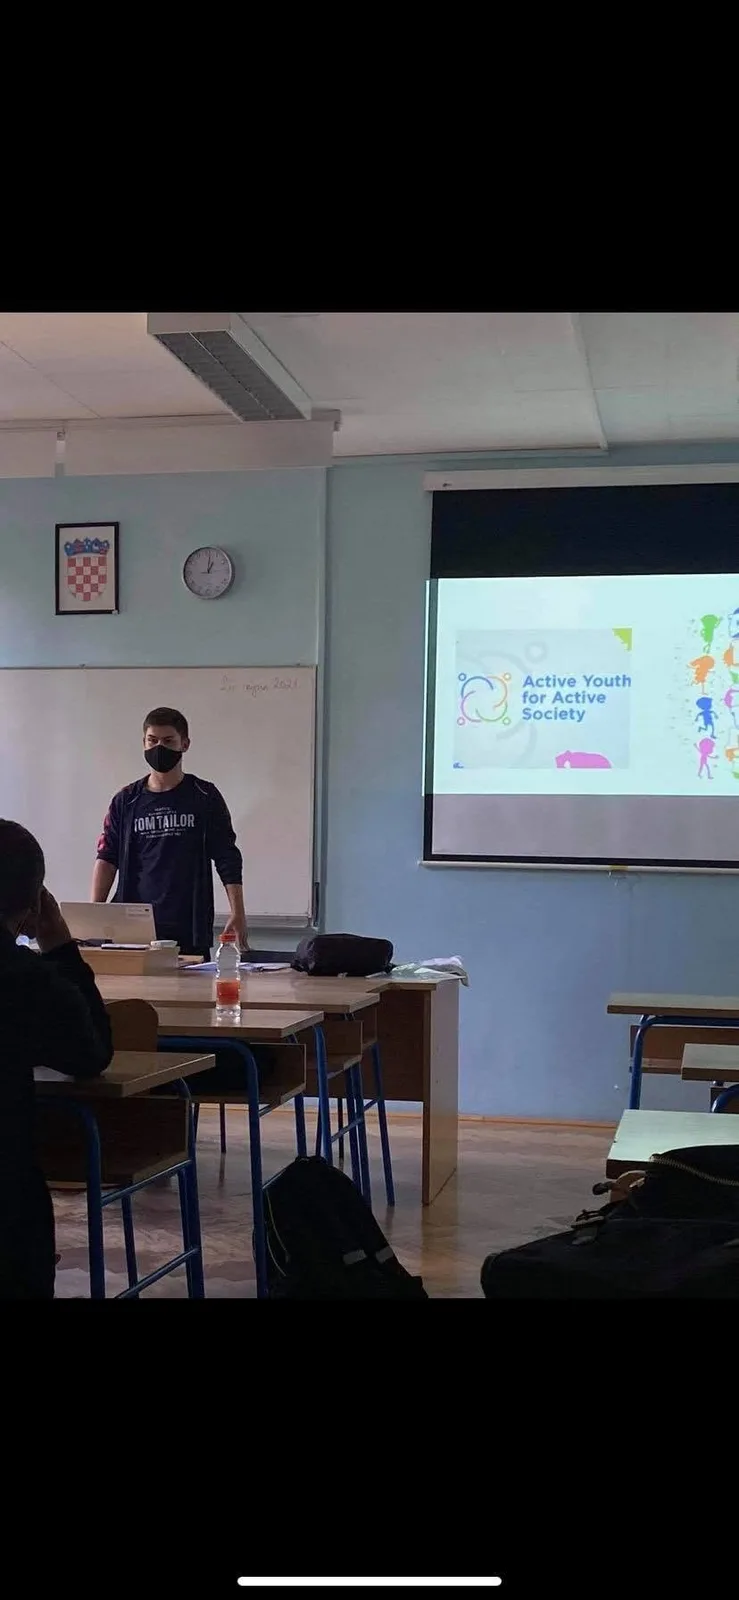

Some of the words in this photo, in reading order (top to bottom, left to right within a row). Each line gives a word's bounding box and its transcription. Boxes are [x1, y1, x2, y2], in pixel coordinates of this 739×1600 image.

[522, 675, 576, 688] Active
[583, 674, 632, 688] Youth
[522, 691, 546, 704] for
[552, 691, 607, 704] Active
[522, 707, 586, 722] Society
[156, 814, 195, 829] TAILOR
